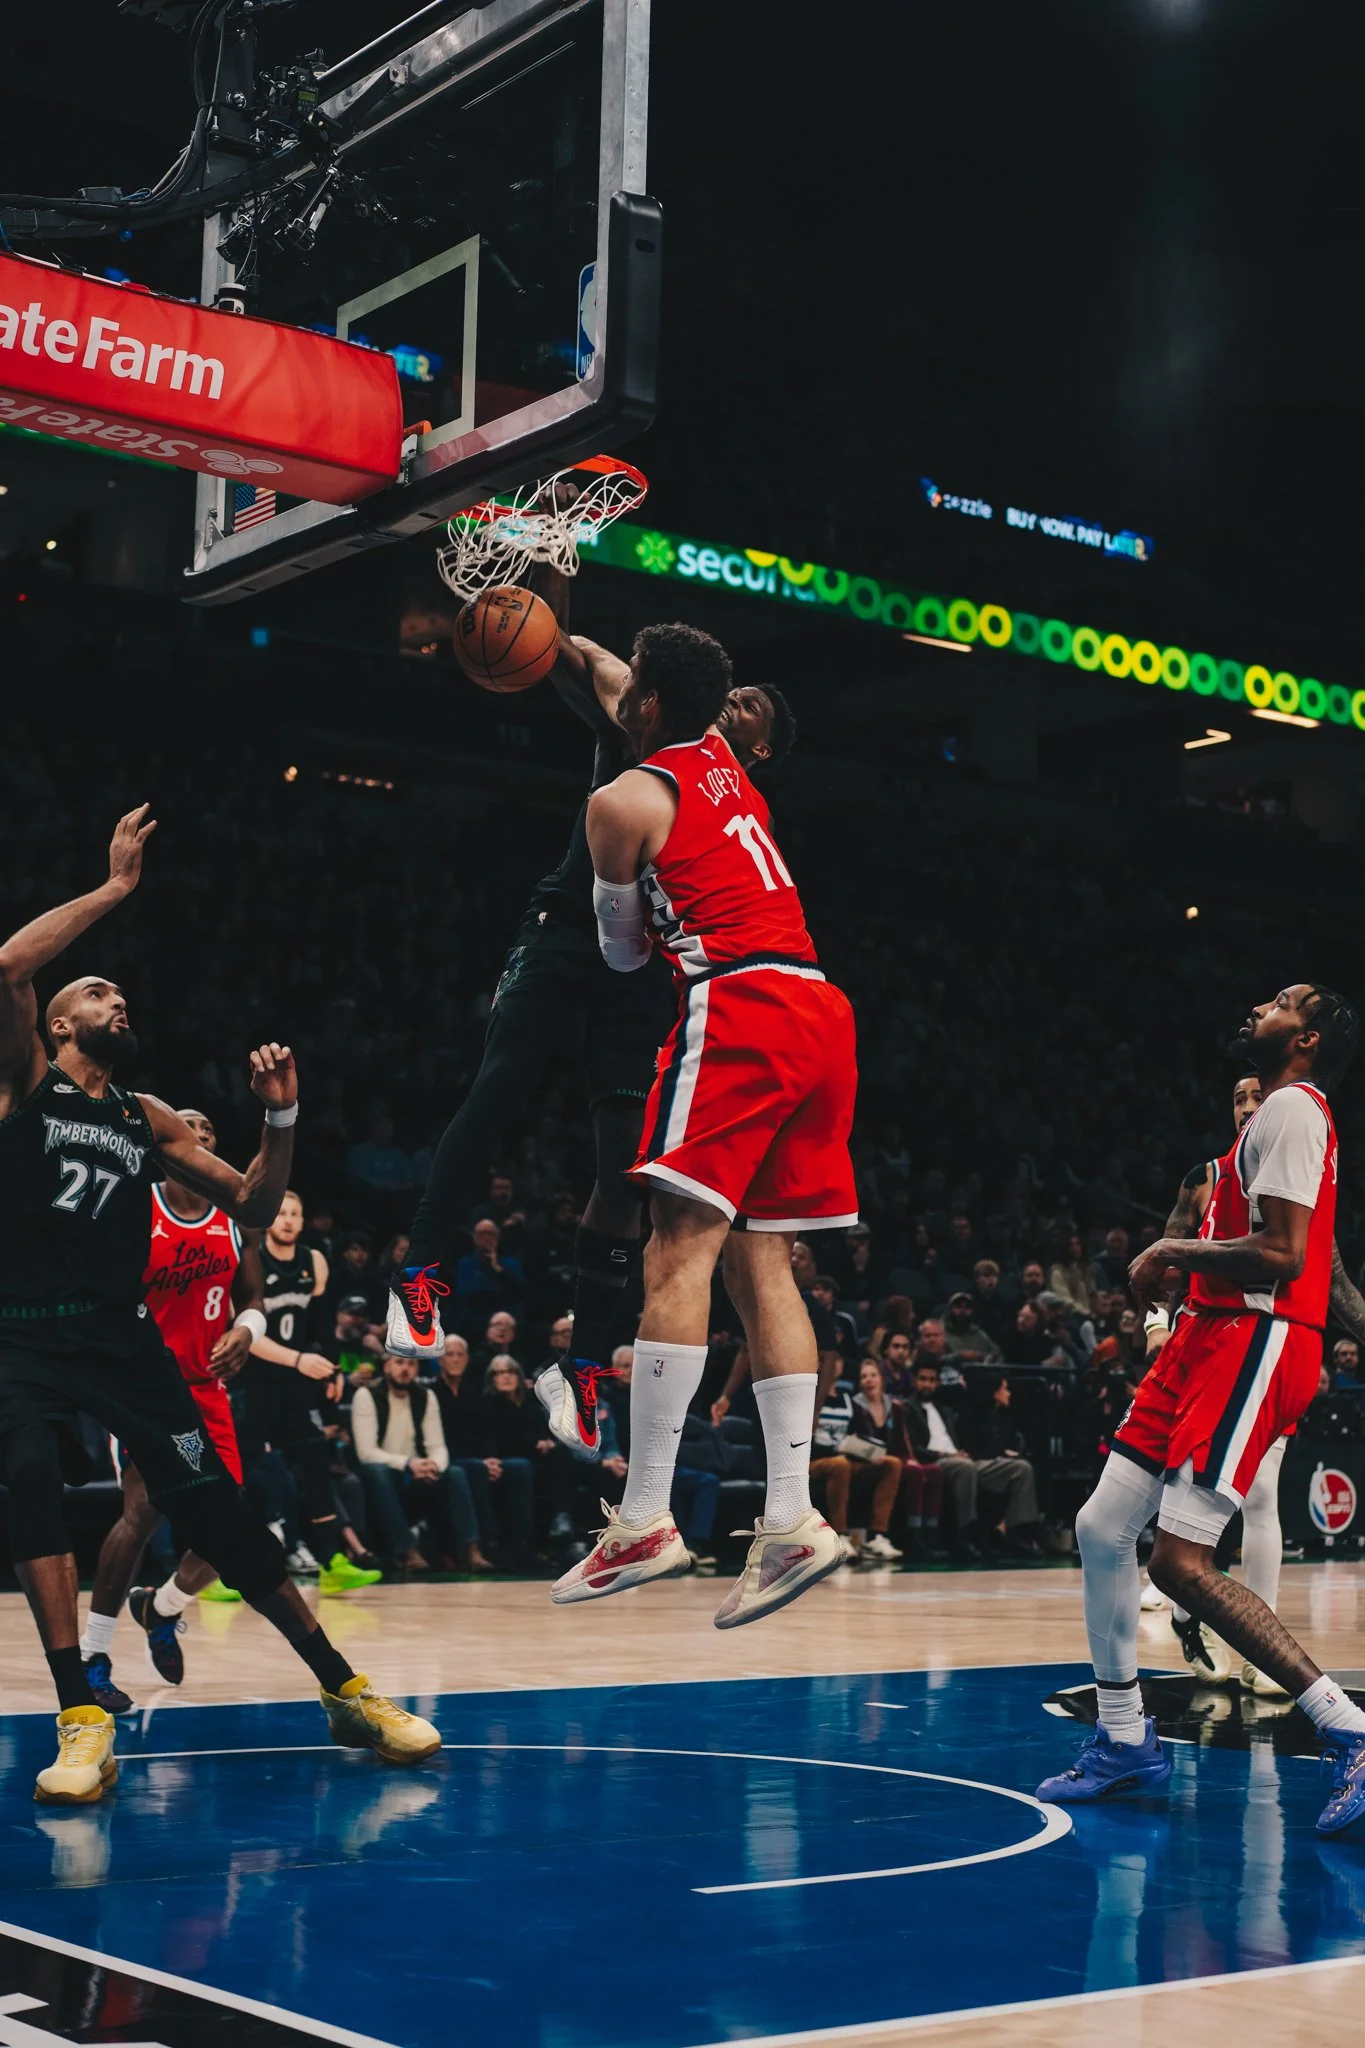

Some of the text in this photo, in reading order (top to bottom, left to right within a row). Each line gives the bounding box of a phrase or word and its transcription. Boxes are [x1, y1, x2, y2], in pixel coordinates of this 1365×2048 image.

[1006, 507, 1037, 531] BUY
[1077, 525, 1104, 548] PAY
[697, 767, 741, 806] LOPEZ
[722, 814, 794, 891] 11
[52, 1155, 124, 1219] 27
[172, 1240, 207, 1268] Los
[609, 1248, 628, 1263] 5
[147, 1252, 231, 1296] Angeles
[204, 1286, 224, 1321] 8
[280, 1313, 294, 1341] 0
